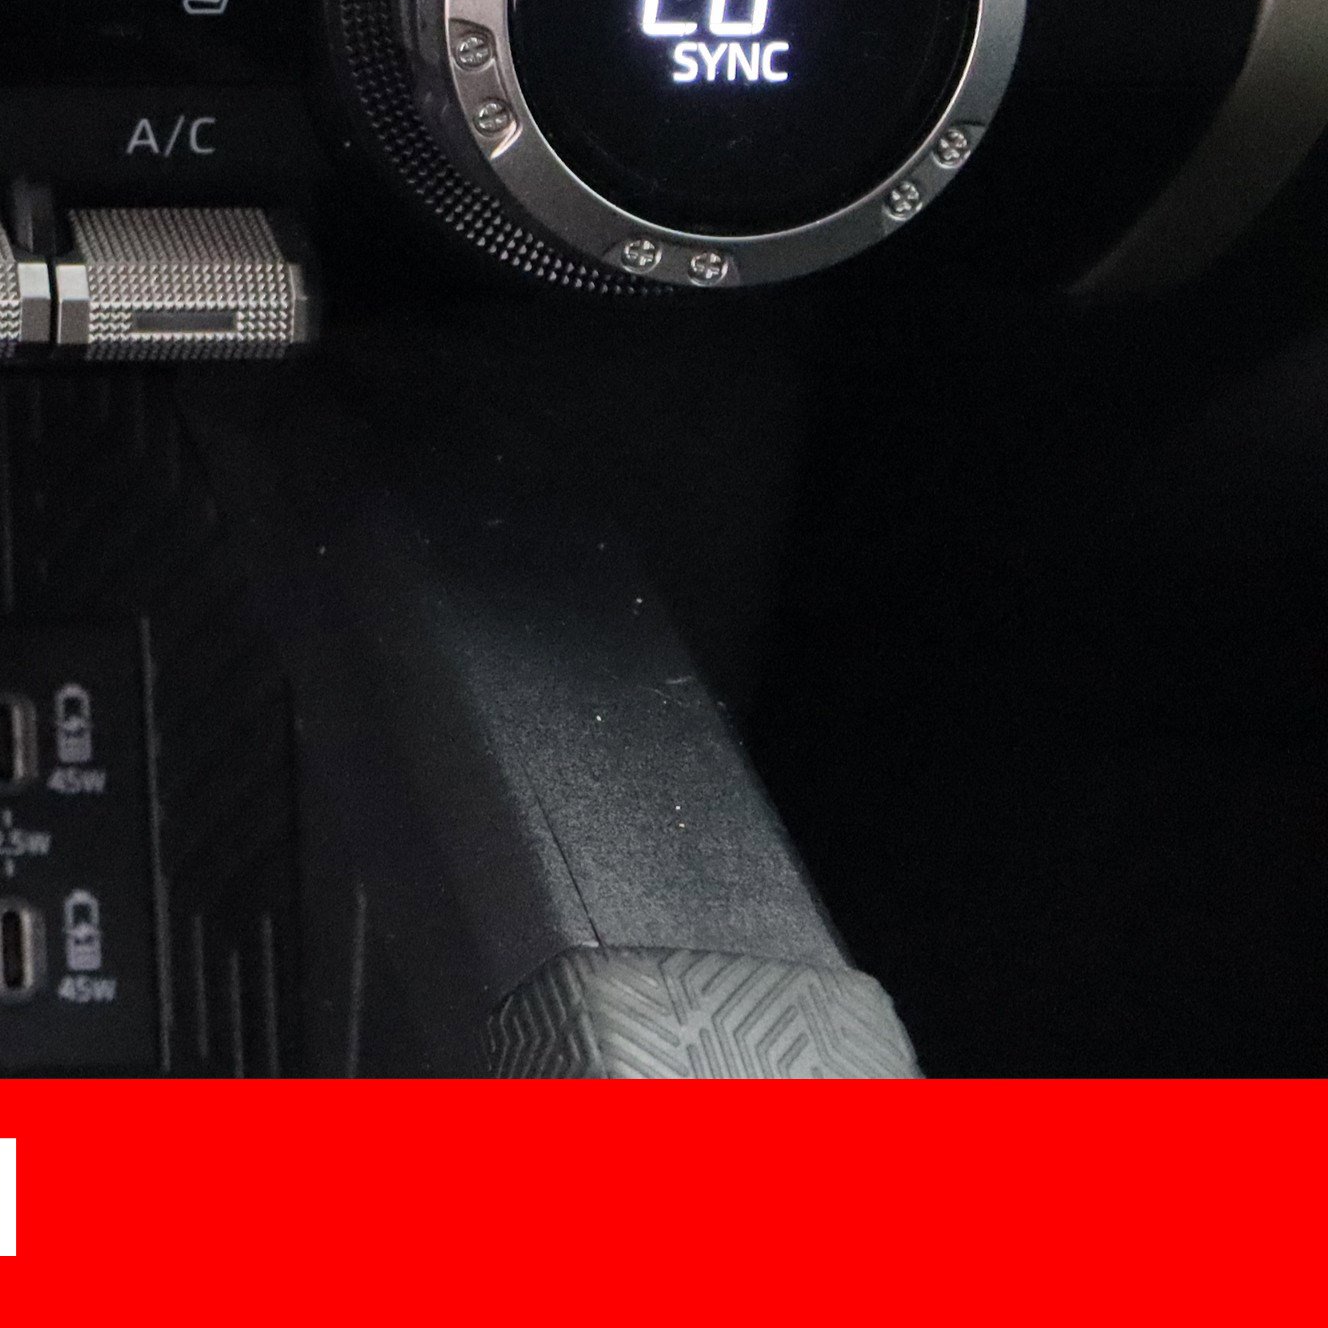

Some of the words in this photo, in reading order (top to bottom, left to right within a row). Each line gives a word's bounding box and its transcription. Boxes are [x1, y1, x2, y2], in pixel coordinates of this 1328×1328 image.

[672, 43, 788, 83] SYNC
[127, 115, 215, 157] A/C
[47, 768, 107, 794] 45W
[58, 975, 117, 1003] 45W
